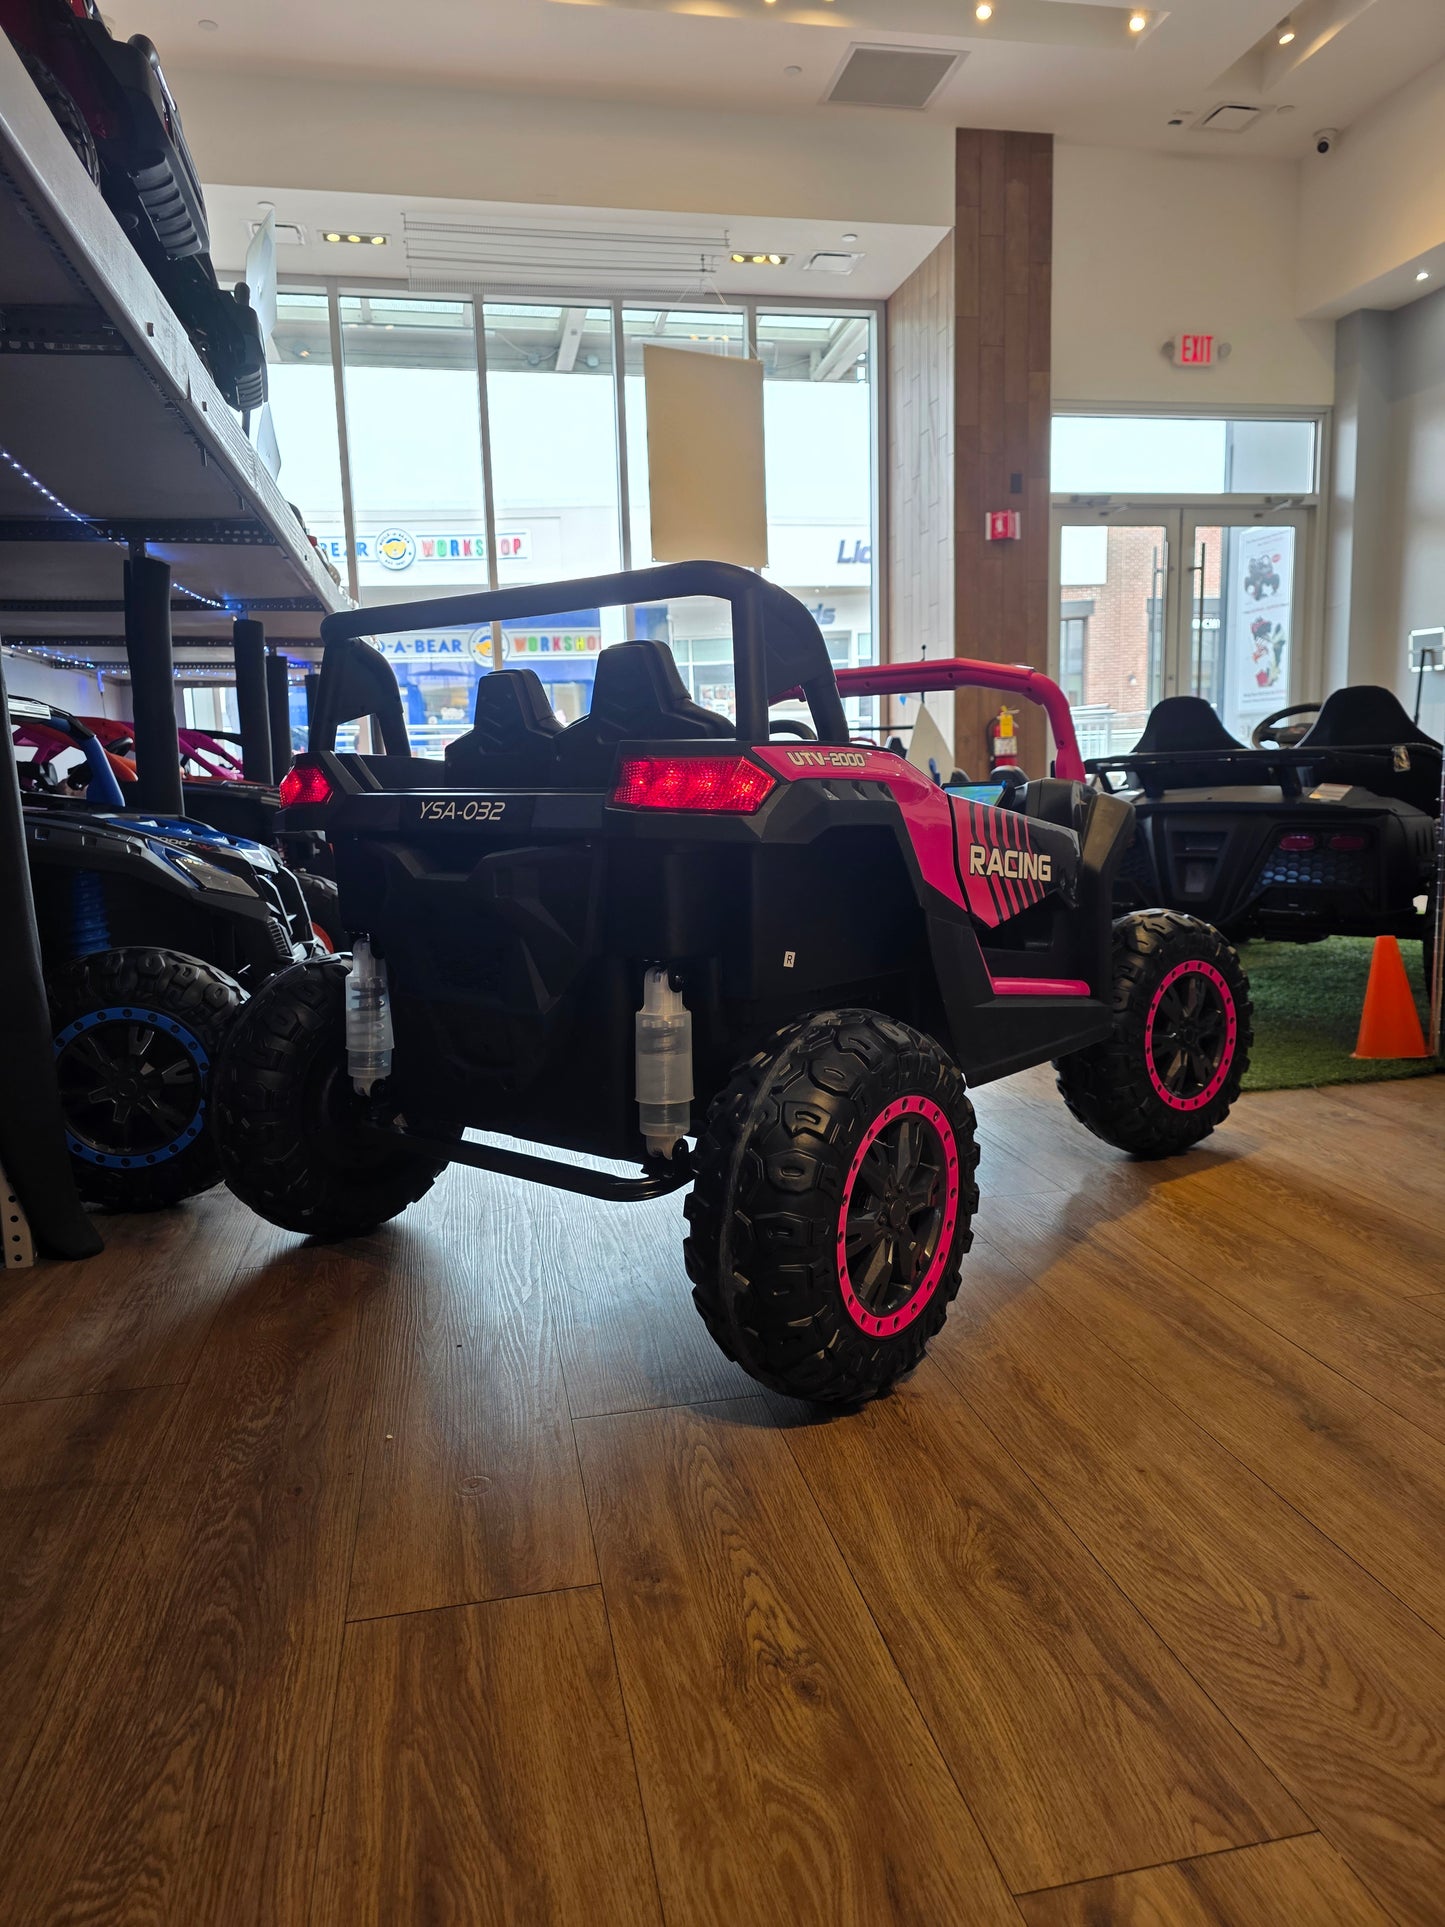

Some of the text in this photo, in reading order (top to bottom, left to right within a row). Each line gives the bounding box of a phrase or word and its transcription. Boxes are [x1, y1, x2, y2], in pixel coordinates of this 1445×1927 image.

[1182, 335, 1213, 363] EXIT
[422, 538, 521, 557] WORKSOP
[514, 635, 601, 653] WORKSHO
[786, 751, 866, 767] UTV-2000
[420, 801, 506, 820] YSA-032
[970, 844, 1052, 882] RACING
